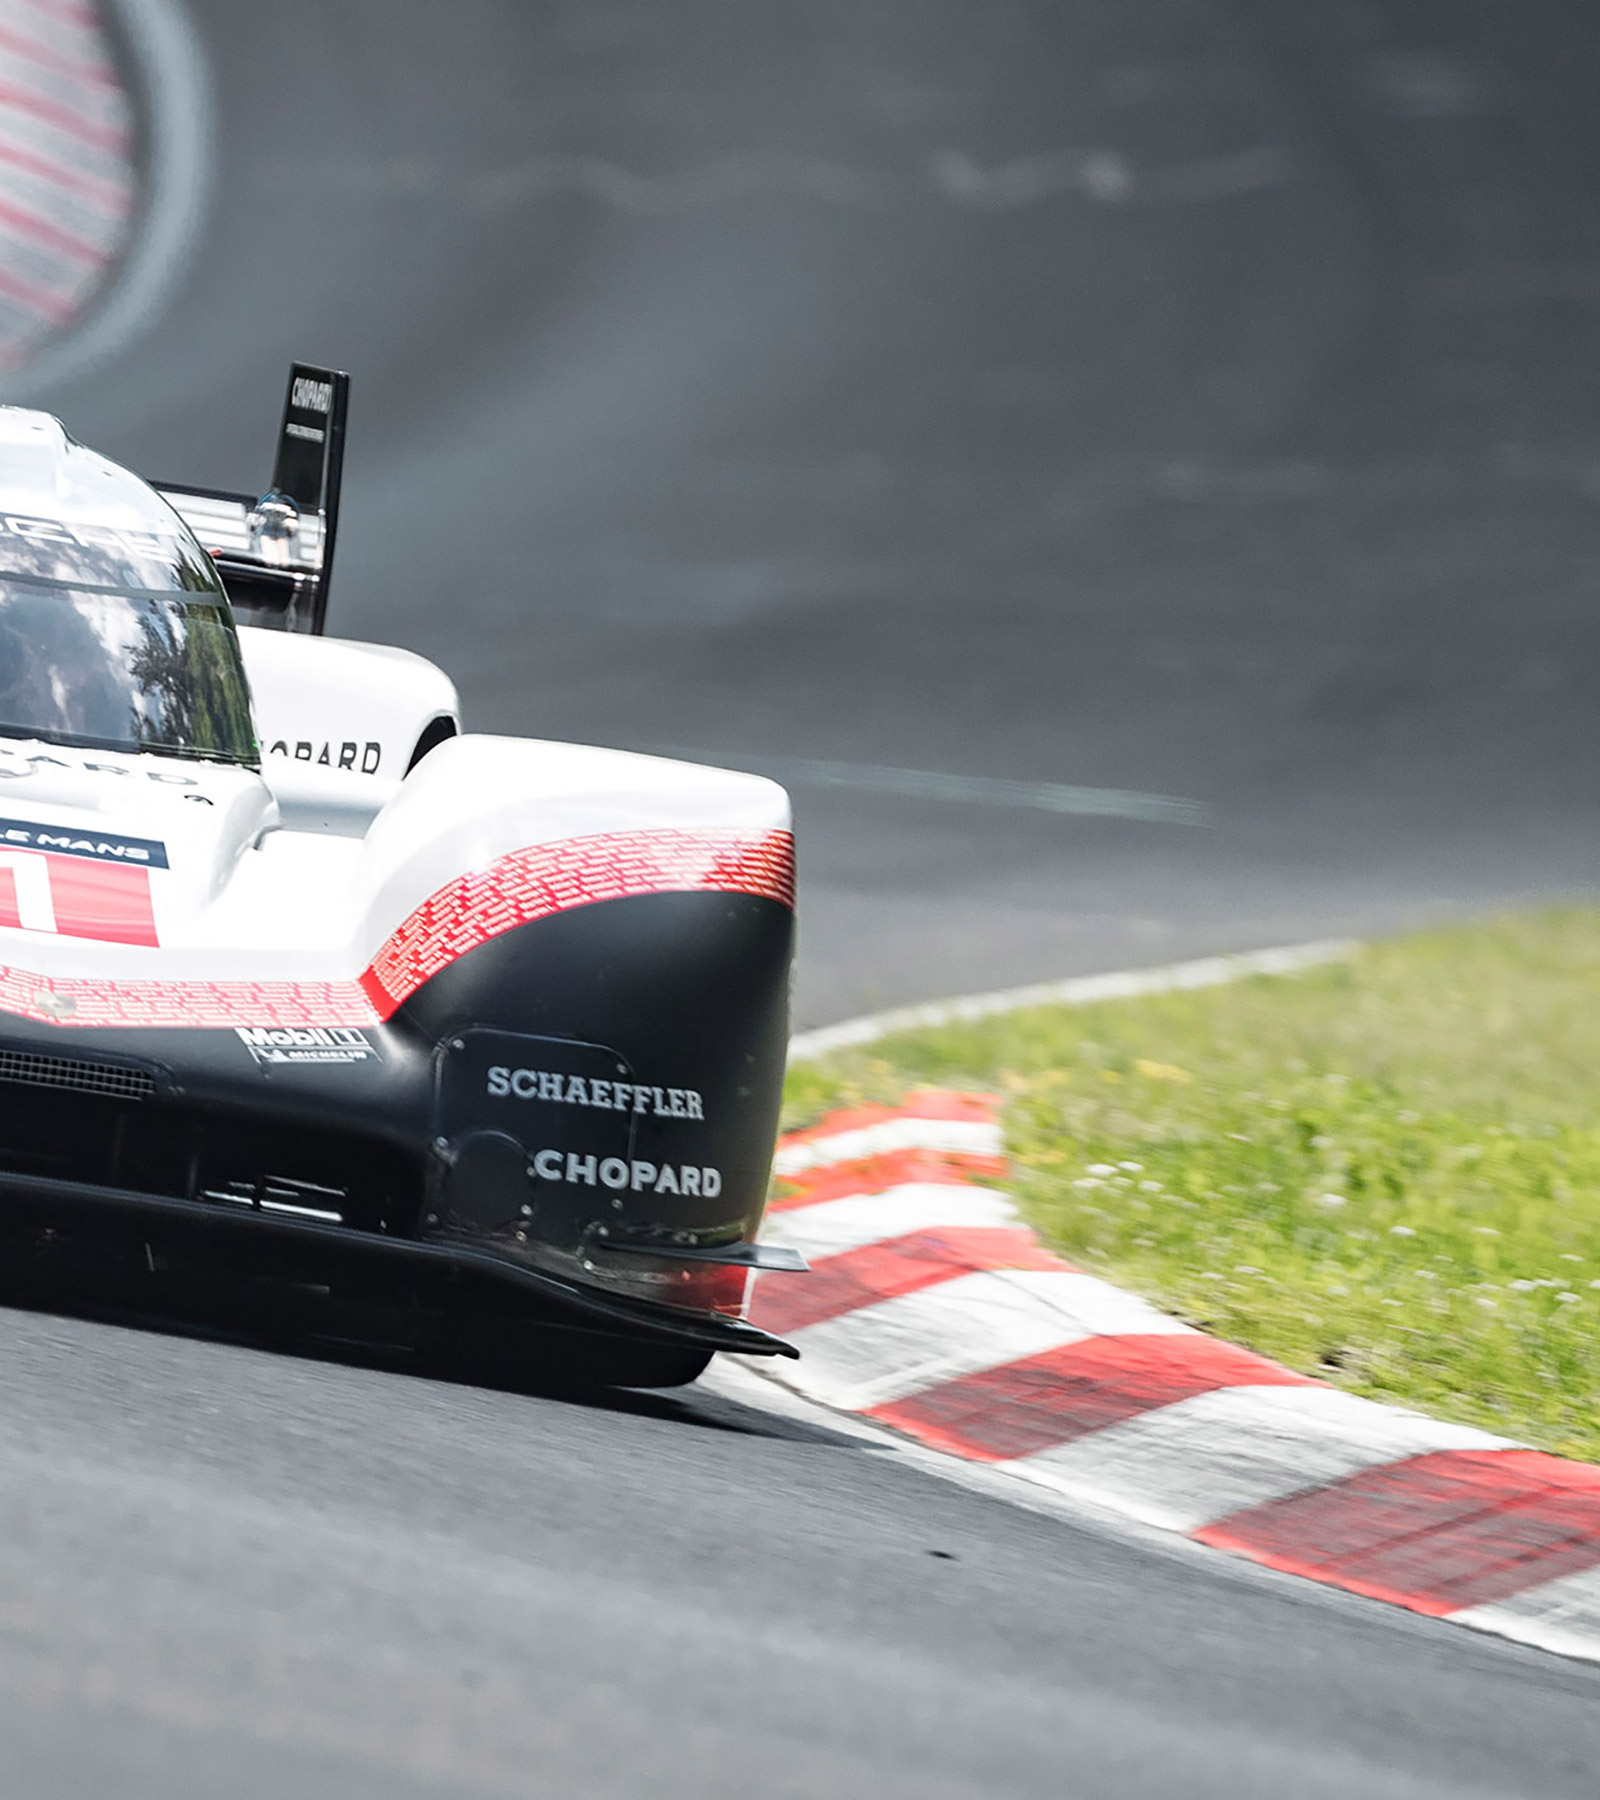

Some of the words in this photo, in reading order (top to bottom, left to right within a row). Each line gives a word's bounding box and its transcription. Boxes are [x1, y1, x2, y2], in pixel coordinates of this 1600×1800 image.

[266, 740, 381, 775] OPARD
[37, 834, 149, 860] MANS
[234, 1027, 336, 1046] Mobil
[487, 1065, 705, 1121] SCHAEFFLER
[533, 1149, 722, 1198] CHOPARD
